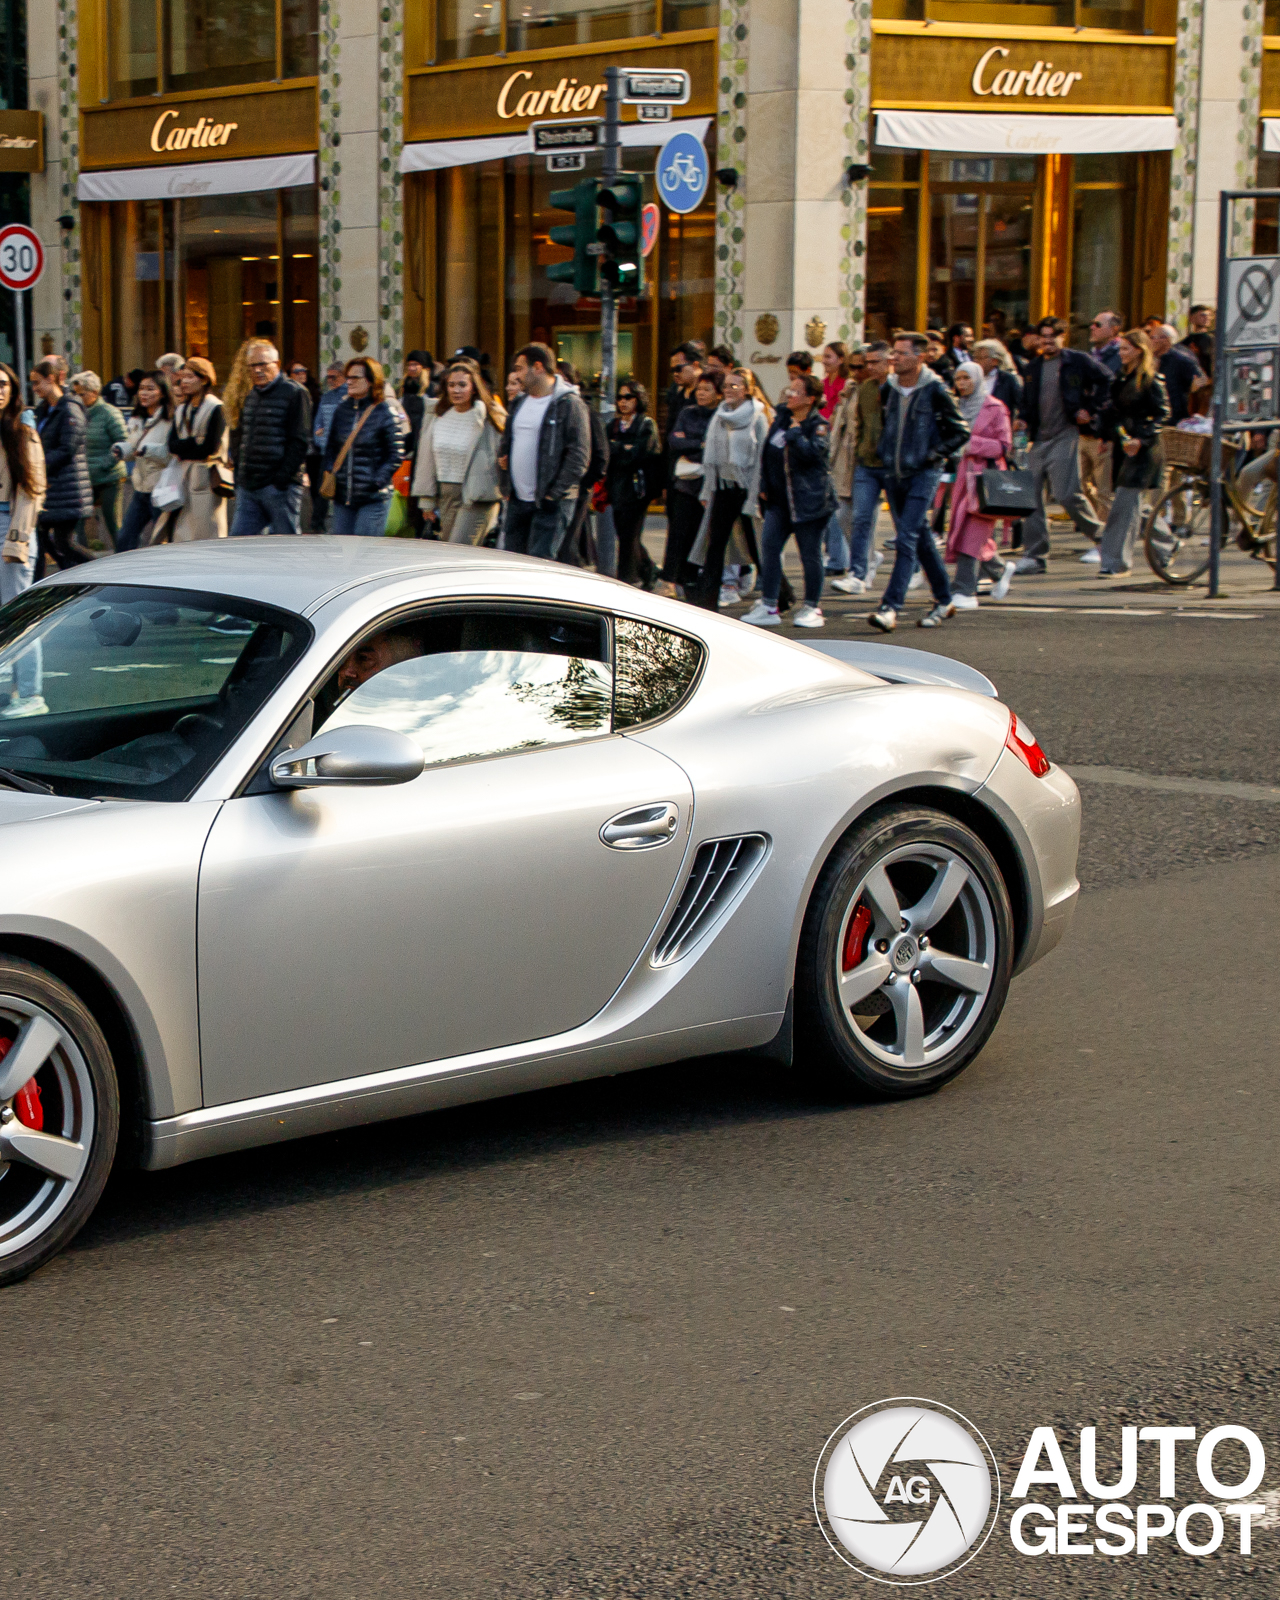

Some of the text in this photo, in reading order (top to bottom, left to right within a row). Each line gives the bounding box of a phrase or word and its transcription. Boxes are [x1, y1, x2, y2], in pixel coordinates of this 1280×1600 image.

[972, 45, 1083, 97] Cartier
[497, 70, 608, 119] Cartier
[150, 109, 238, 152] Cartier
[2, 245, 34, 273] 30
